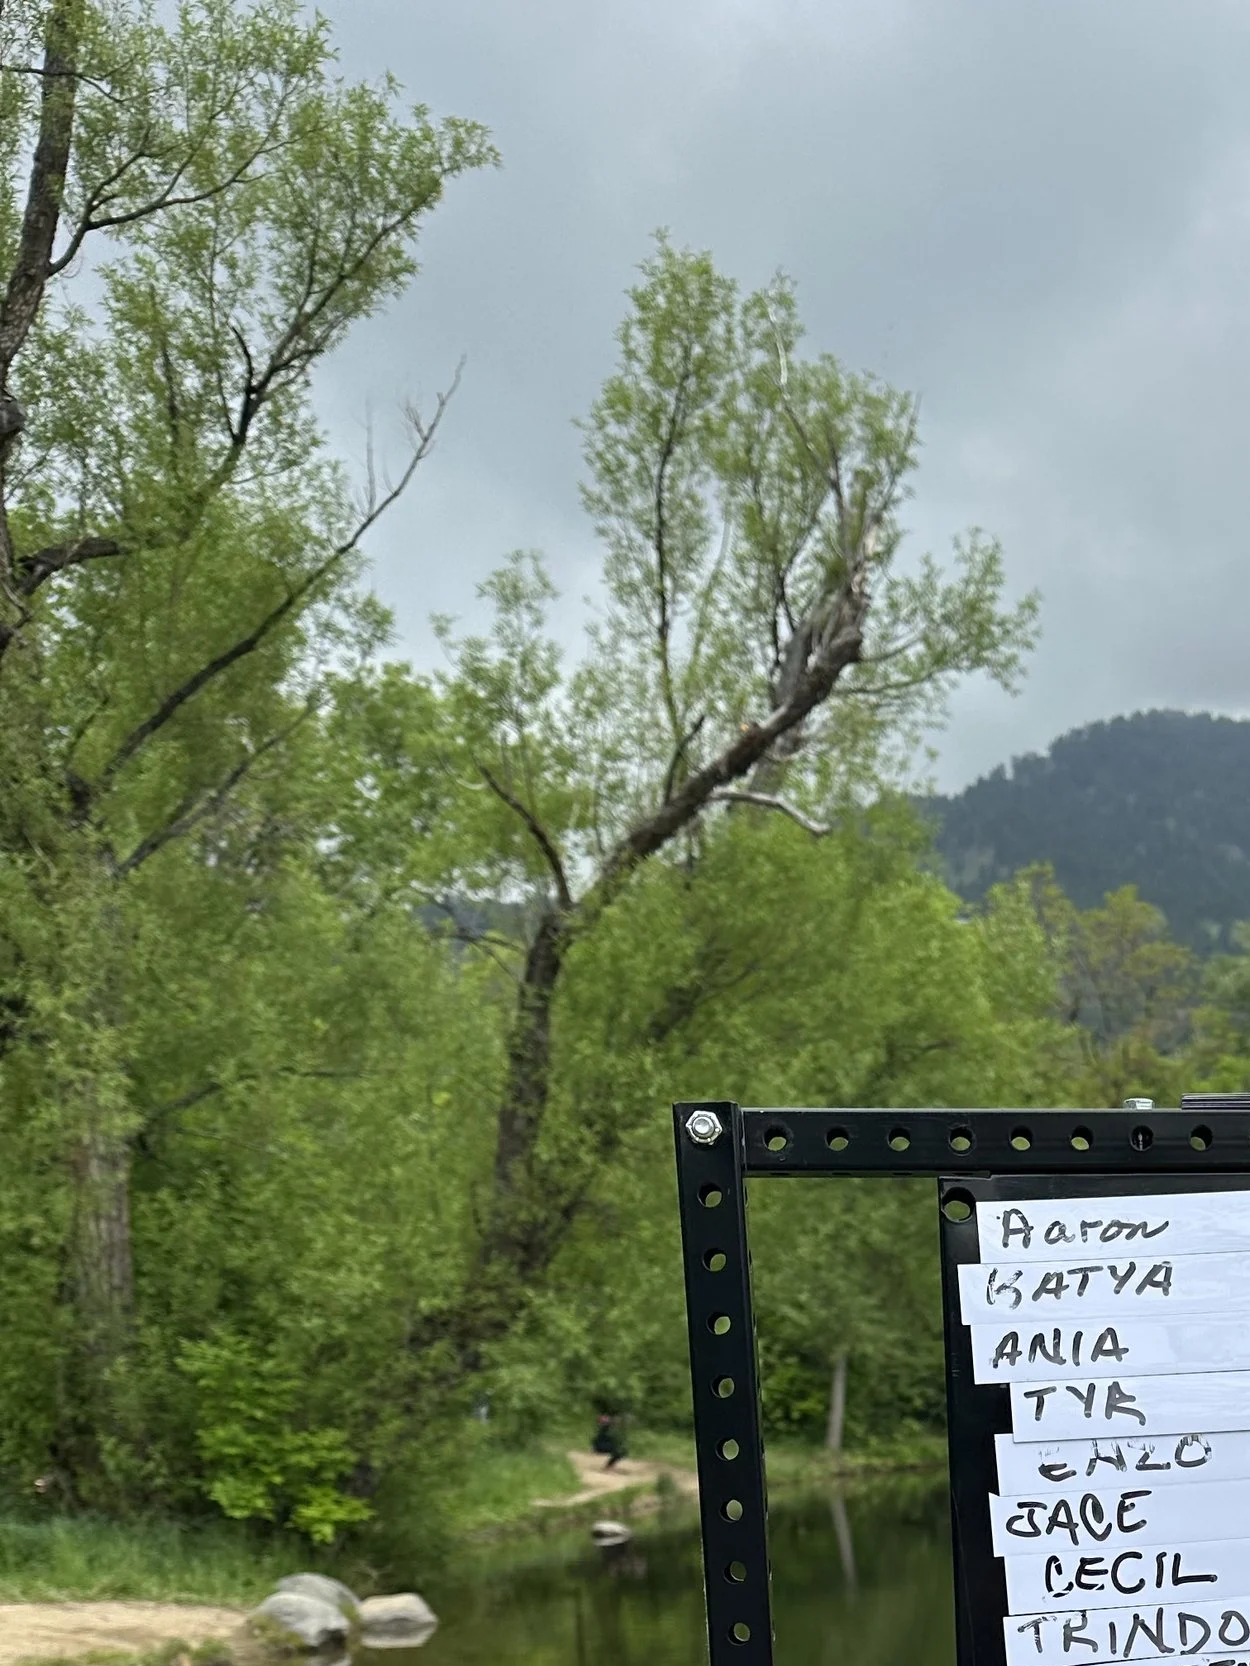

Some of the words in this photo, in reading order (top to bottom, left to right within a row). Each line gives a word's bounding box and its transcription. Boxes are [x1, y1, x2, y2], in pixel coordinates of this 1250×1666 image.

[1000, 1207, 1170, 1249] Aaron
[985, 1260, 1173, 1309] KATYA
[992, 1326, 1130, 1369] ANIA
[1023, 1381, 1146, 1426] TYR
[1004, 1489, 1153, 1546] JACE
[1044, 1550, 1218, 1599] CECIL
